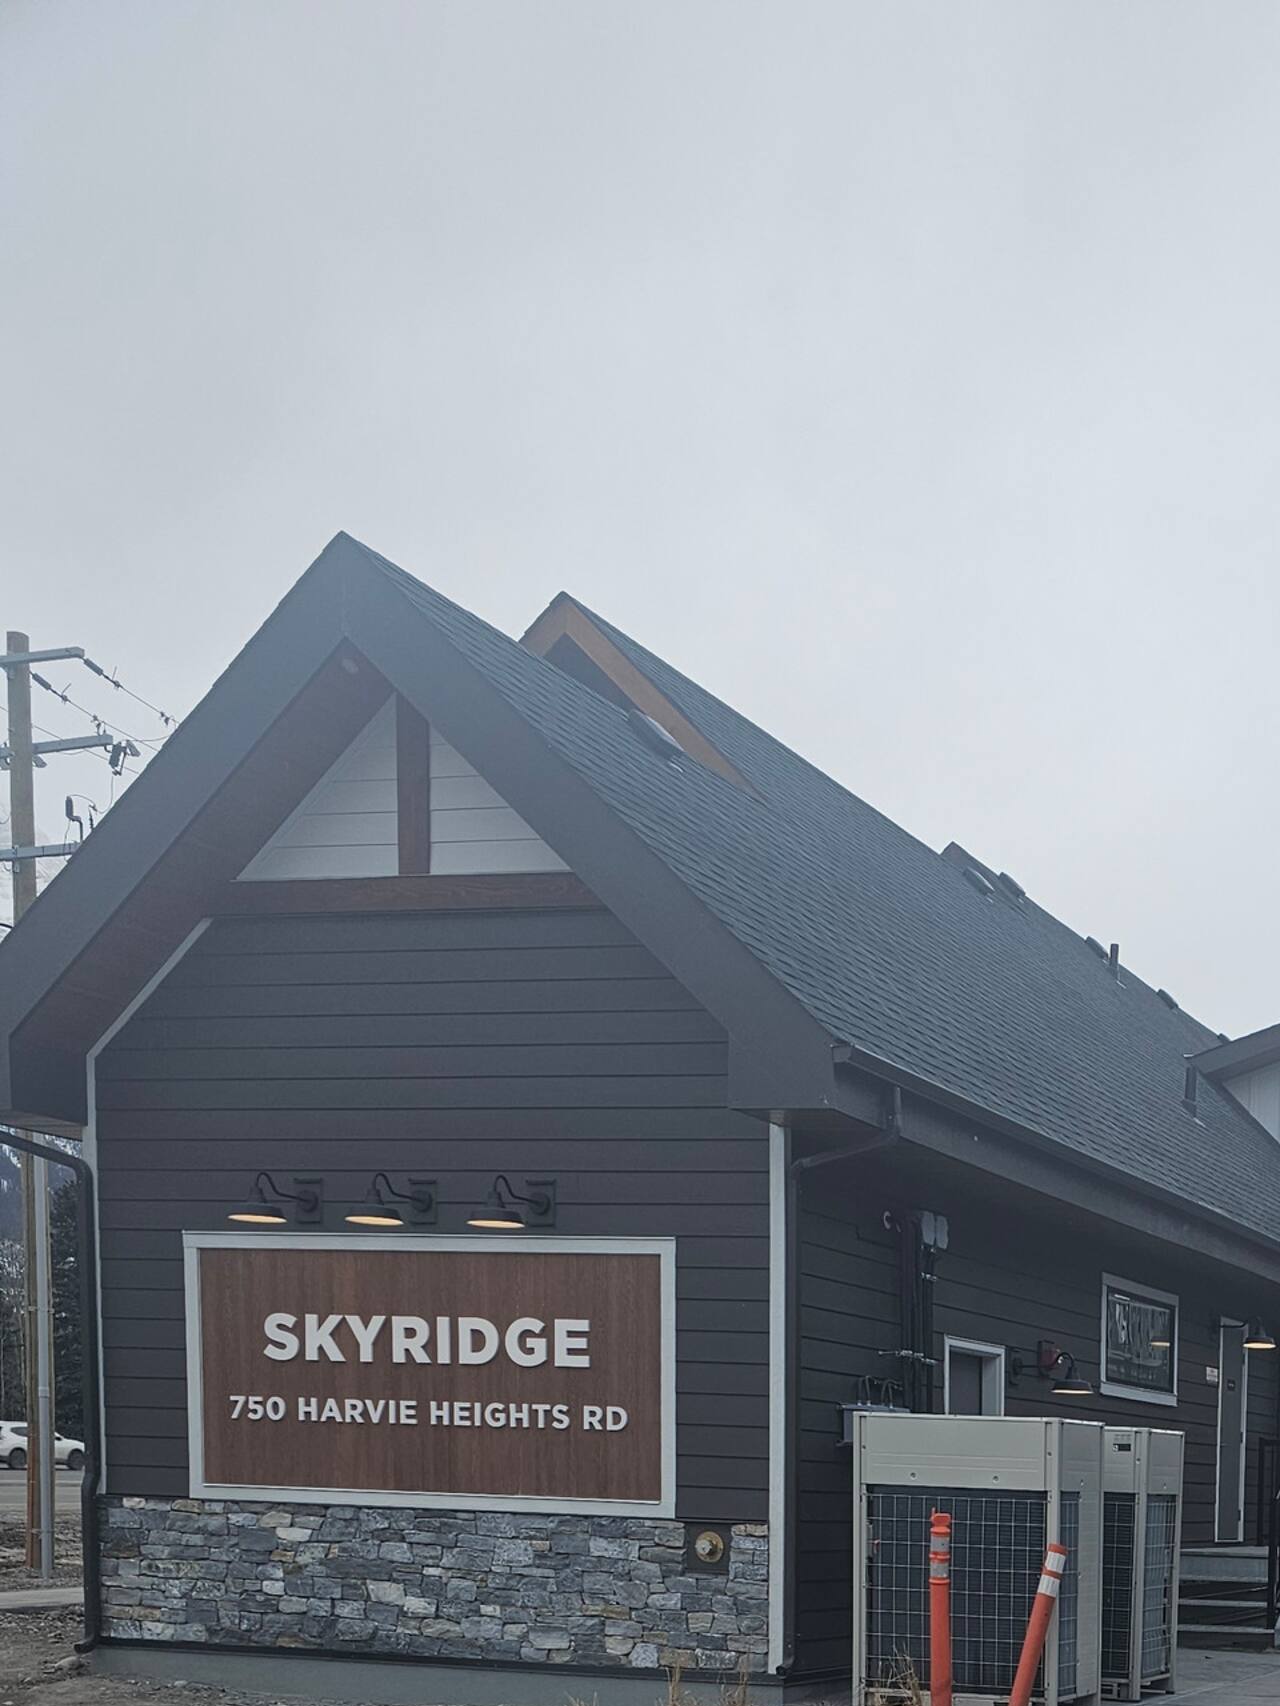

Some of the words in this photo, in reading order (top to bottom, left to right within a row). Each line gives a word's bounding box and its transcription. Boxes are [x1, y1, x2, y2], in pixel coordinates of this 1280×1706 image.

[263, 1312, 591, 1368] SKYRIDGE
[229, 1395, 287, 1422] 750
[298, 1397, 418, 1425] HARVIE
[430, 1401, 570, 1430] HEIGHTS
[583, 1405, 629, 1432] RD
